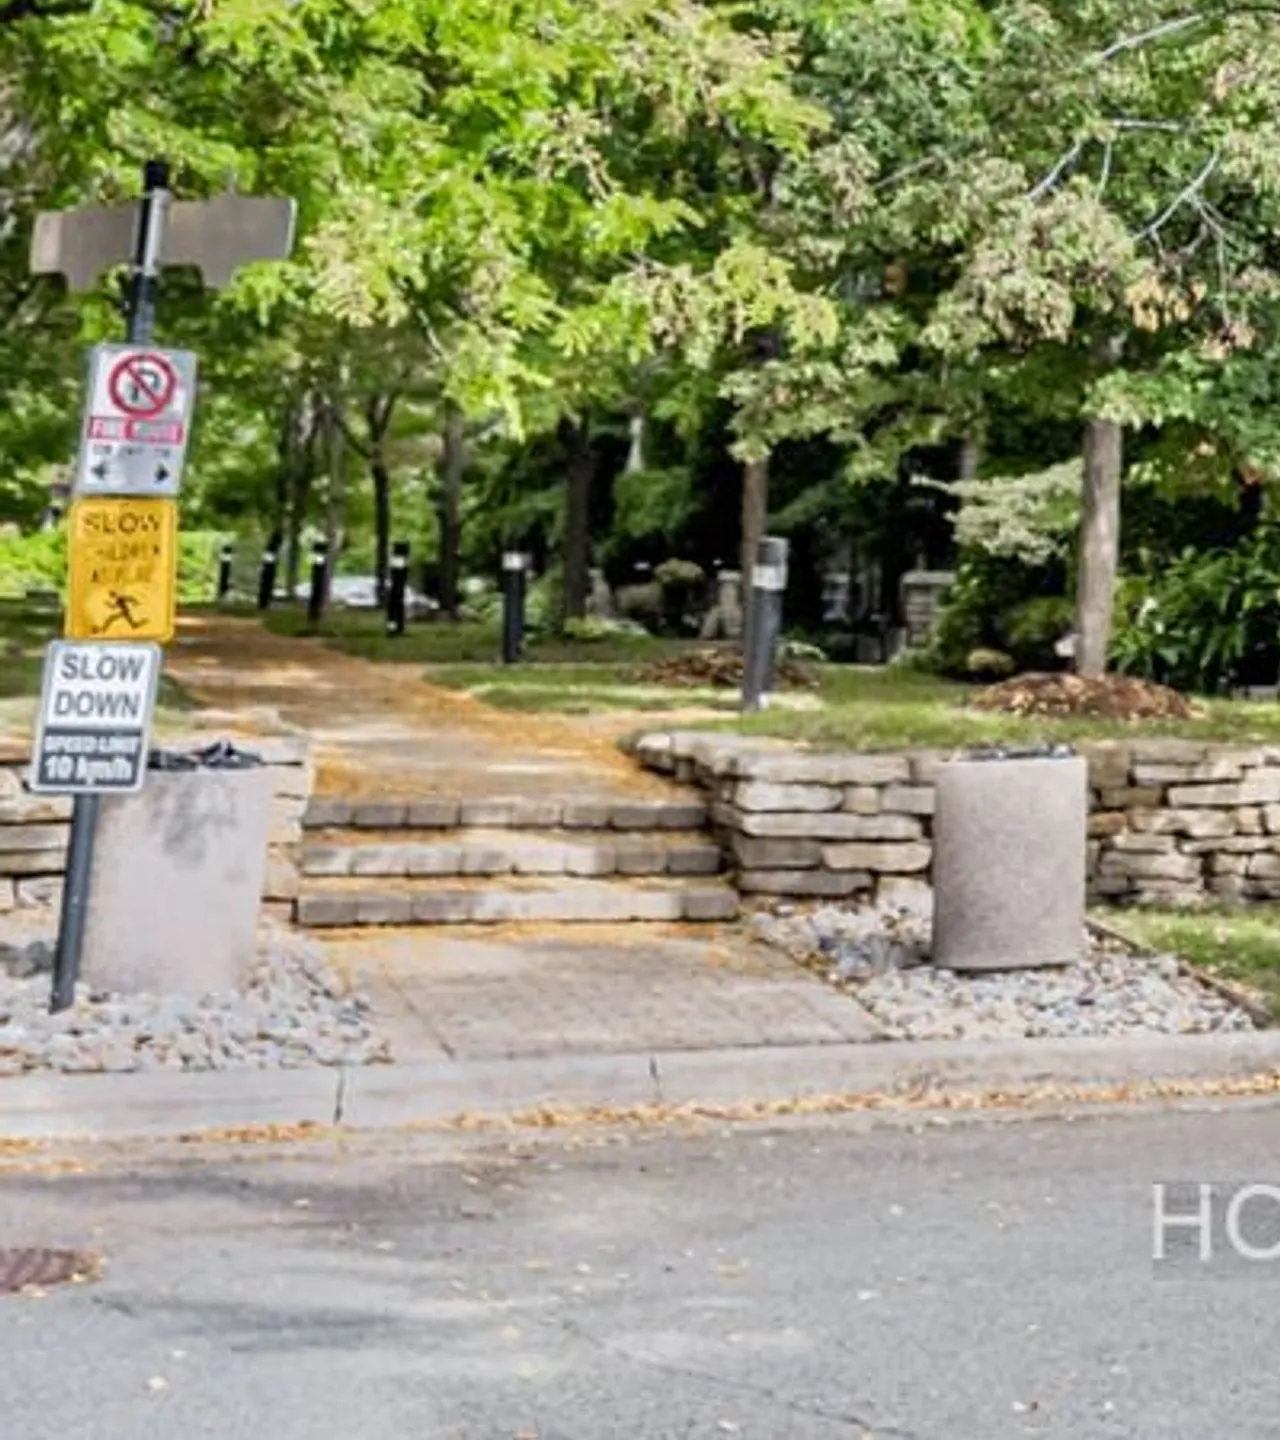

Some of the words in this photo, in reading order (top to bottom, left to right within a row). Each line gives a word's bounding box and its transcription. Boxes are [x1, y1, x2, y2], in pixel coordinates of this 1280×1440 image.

[83, 511, 160, 535] SLOW
[60, 653, 145, 681] SLOW
[54, 690, 141, 718] DOWN
[45, 755, 74, 780] 10
